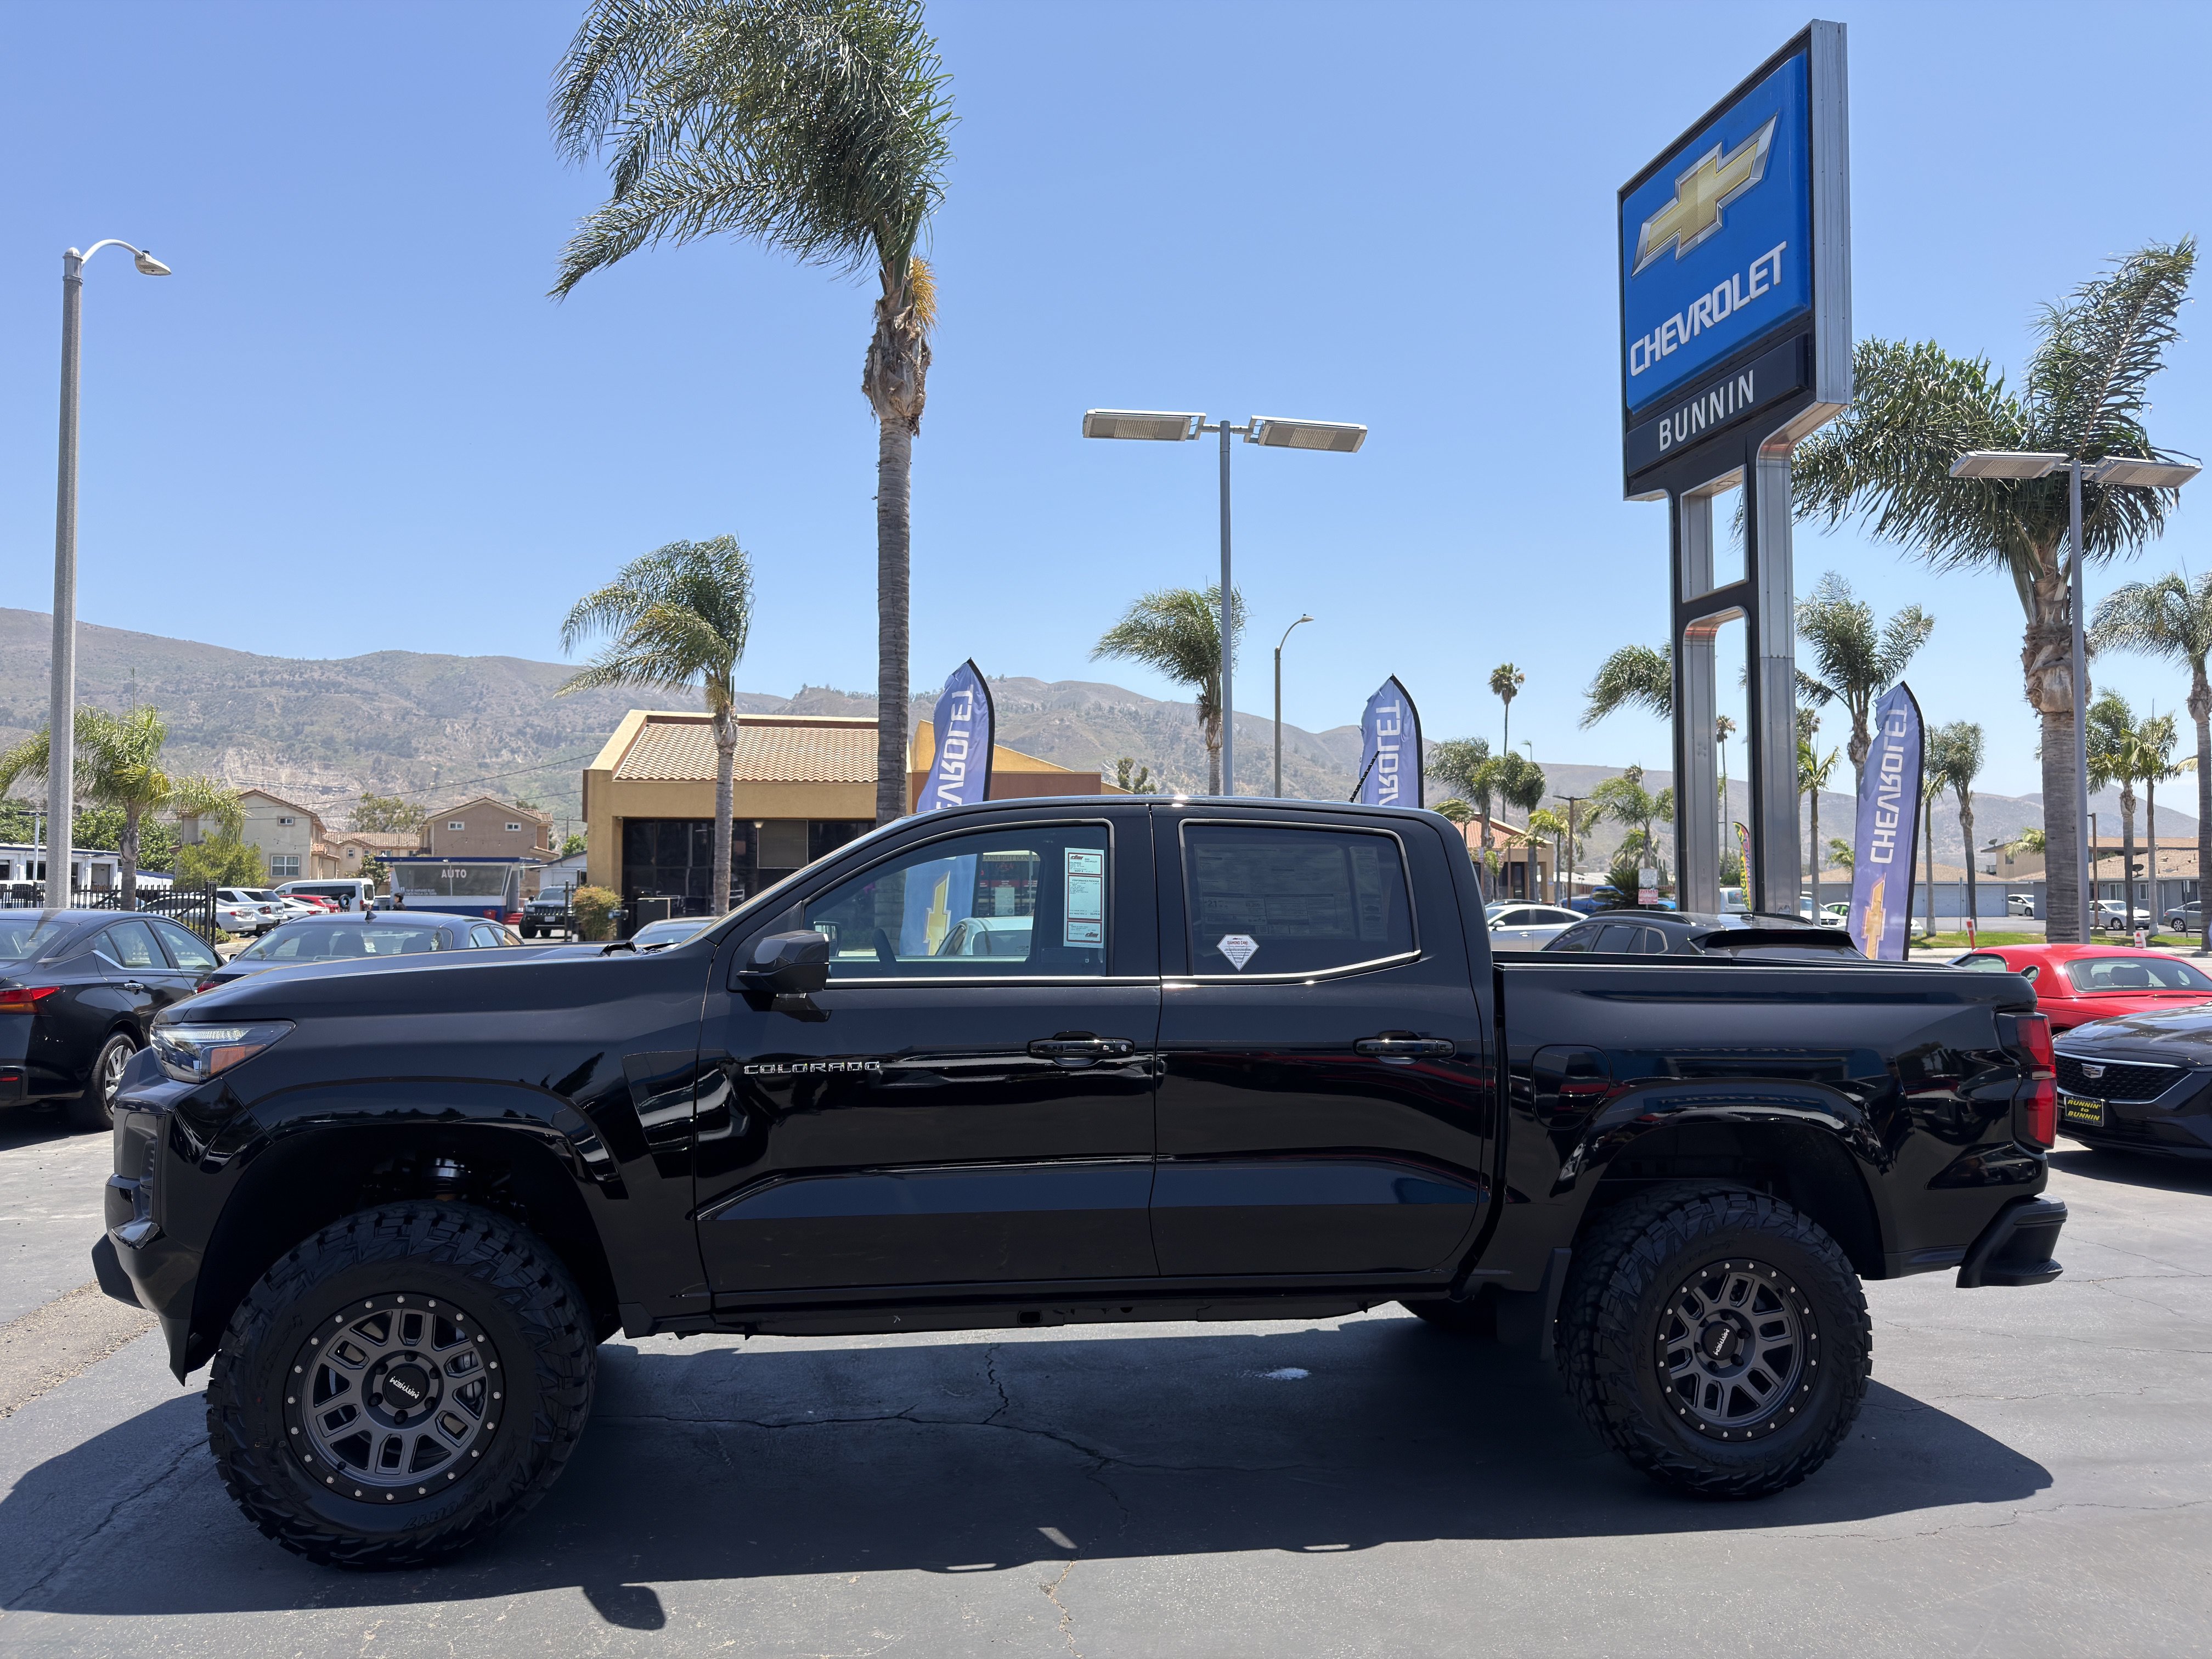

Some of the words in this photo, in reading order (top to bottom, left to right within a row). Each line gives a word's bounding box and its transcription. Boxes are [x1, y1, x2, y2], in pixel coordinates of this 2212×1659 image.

[1630, 241, 1787, 377] CHEVROLET
[1658, 369, 1754, 452] BUNNIN
[441, 869, 467, 878] AUTO
[743, 1061, 880, 1074] COLORADO
[2067, 1099, 2101, 1109] RUNNIN'
[2067, 1110, 2100, 1121] BUNNIN
[1713, 1328, 1730, 1356] MAYHEM
[389, 1376, 420, 1399] MAYHEM
